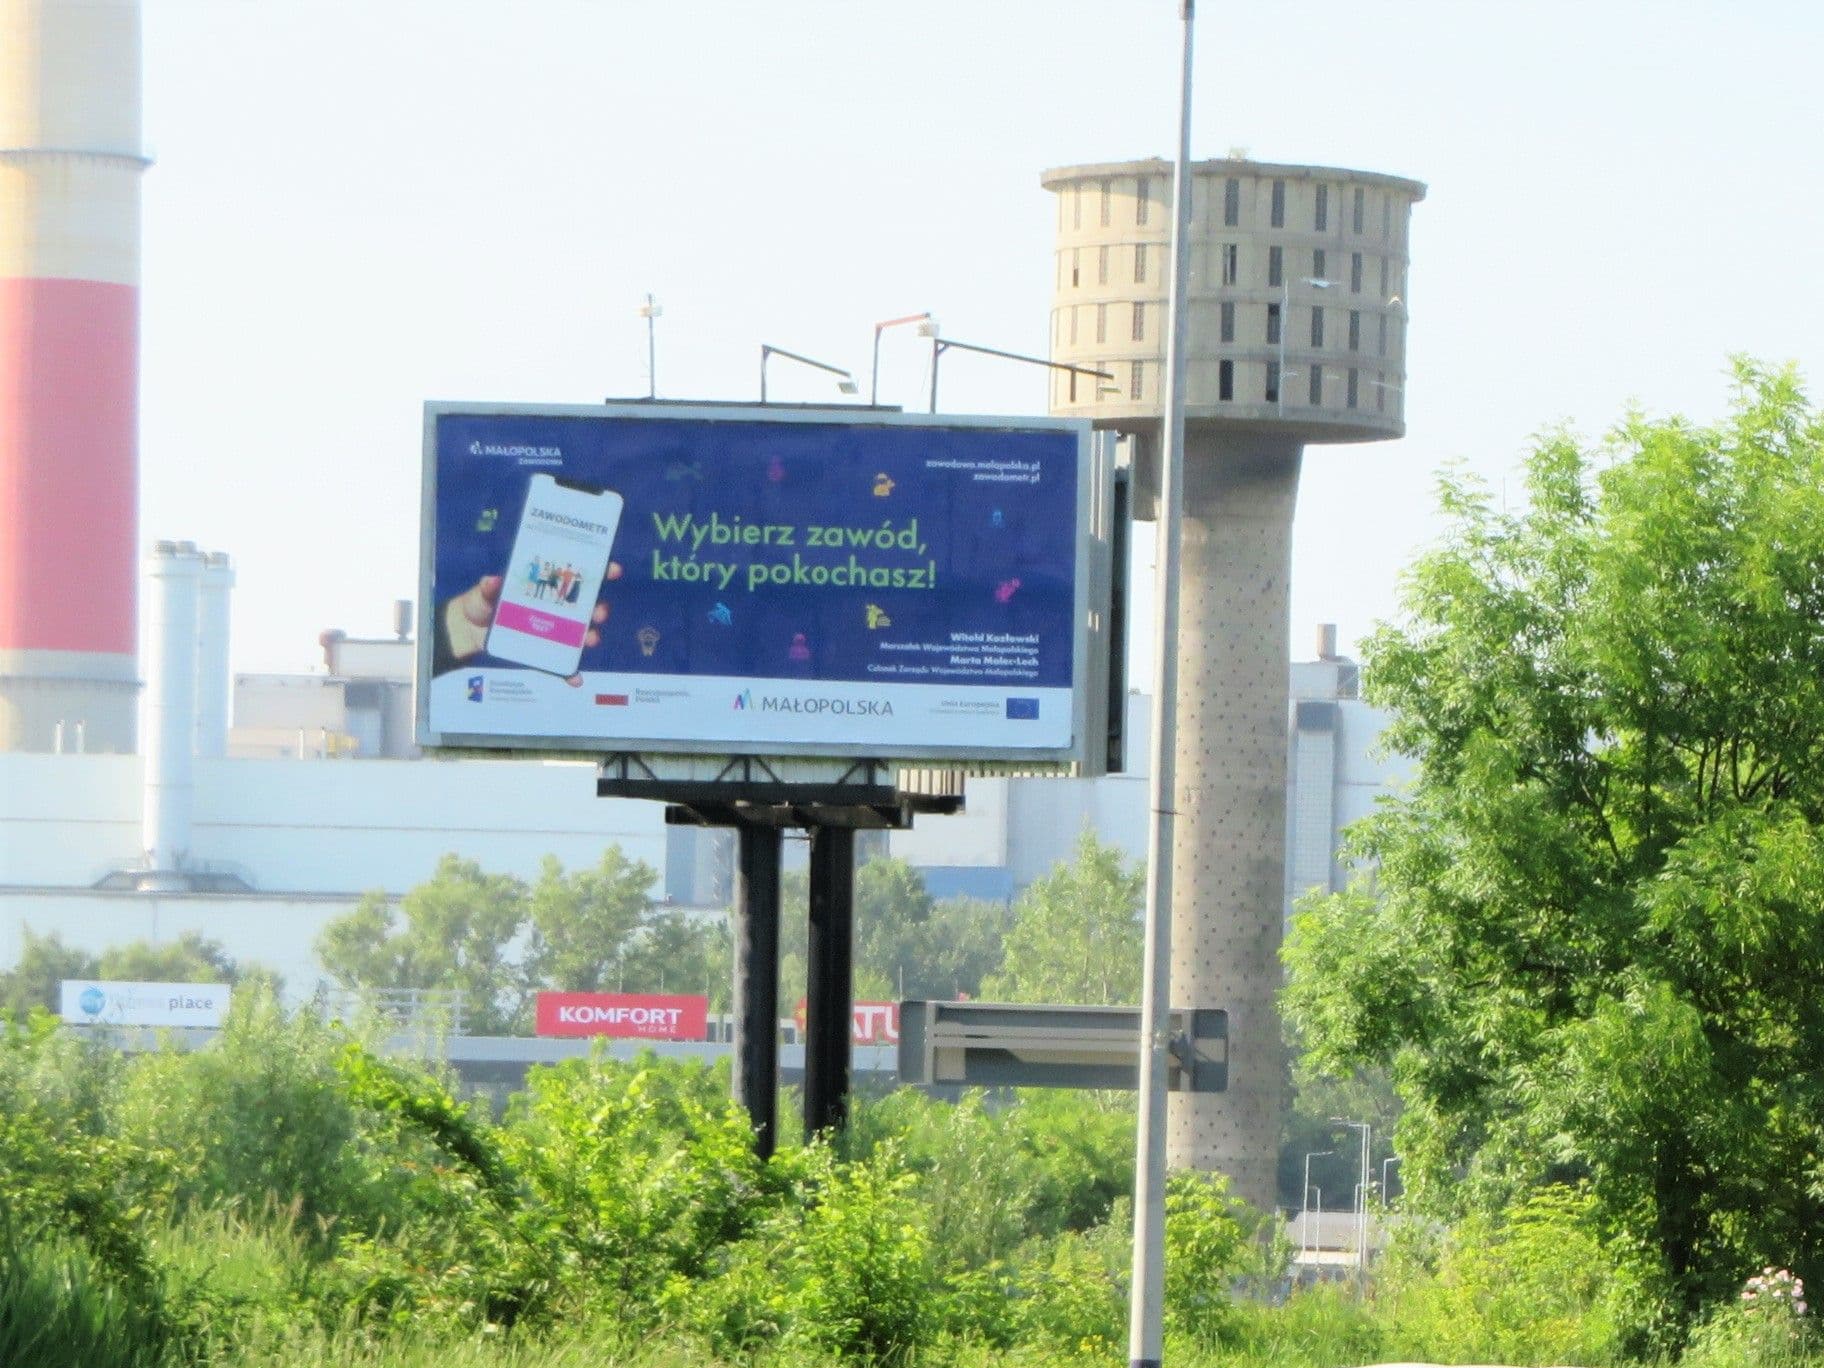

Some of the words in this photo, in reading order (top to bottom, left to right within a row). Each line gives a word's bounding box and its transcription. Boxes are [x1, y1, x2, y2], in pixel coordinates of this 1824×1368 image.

[530, 507, 609, 535] ZAWODOMETR
[653, 512, 795, 551] Wybierz
[807, 518, 927, 555] zawód,
[653, 549, 738, 591] który
[749, 553, 936, 592] pokochasz!
[951, 632, 984, 642] Witold
[950, 655, 981, 665] Marta
[762, 696, 894, 717] MAŁOPOLSKA
[168, 994, 214, 1011] place
[559, 1006, 683, 1025] KOMFORT
[638, 1025, 677, 1034] HOME
